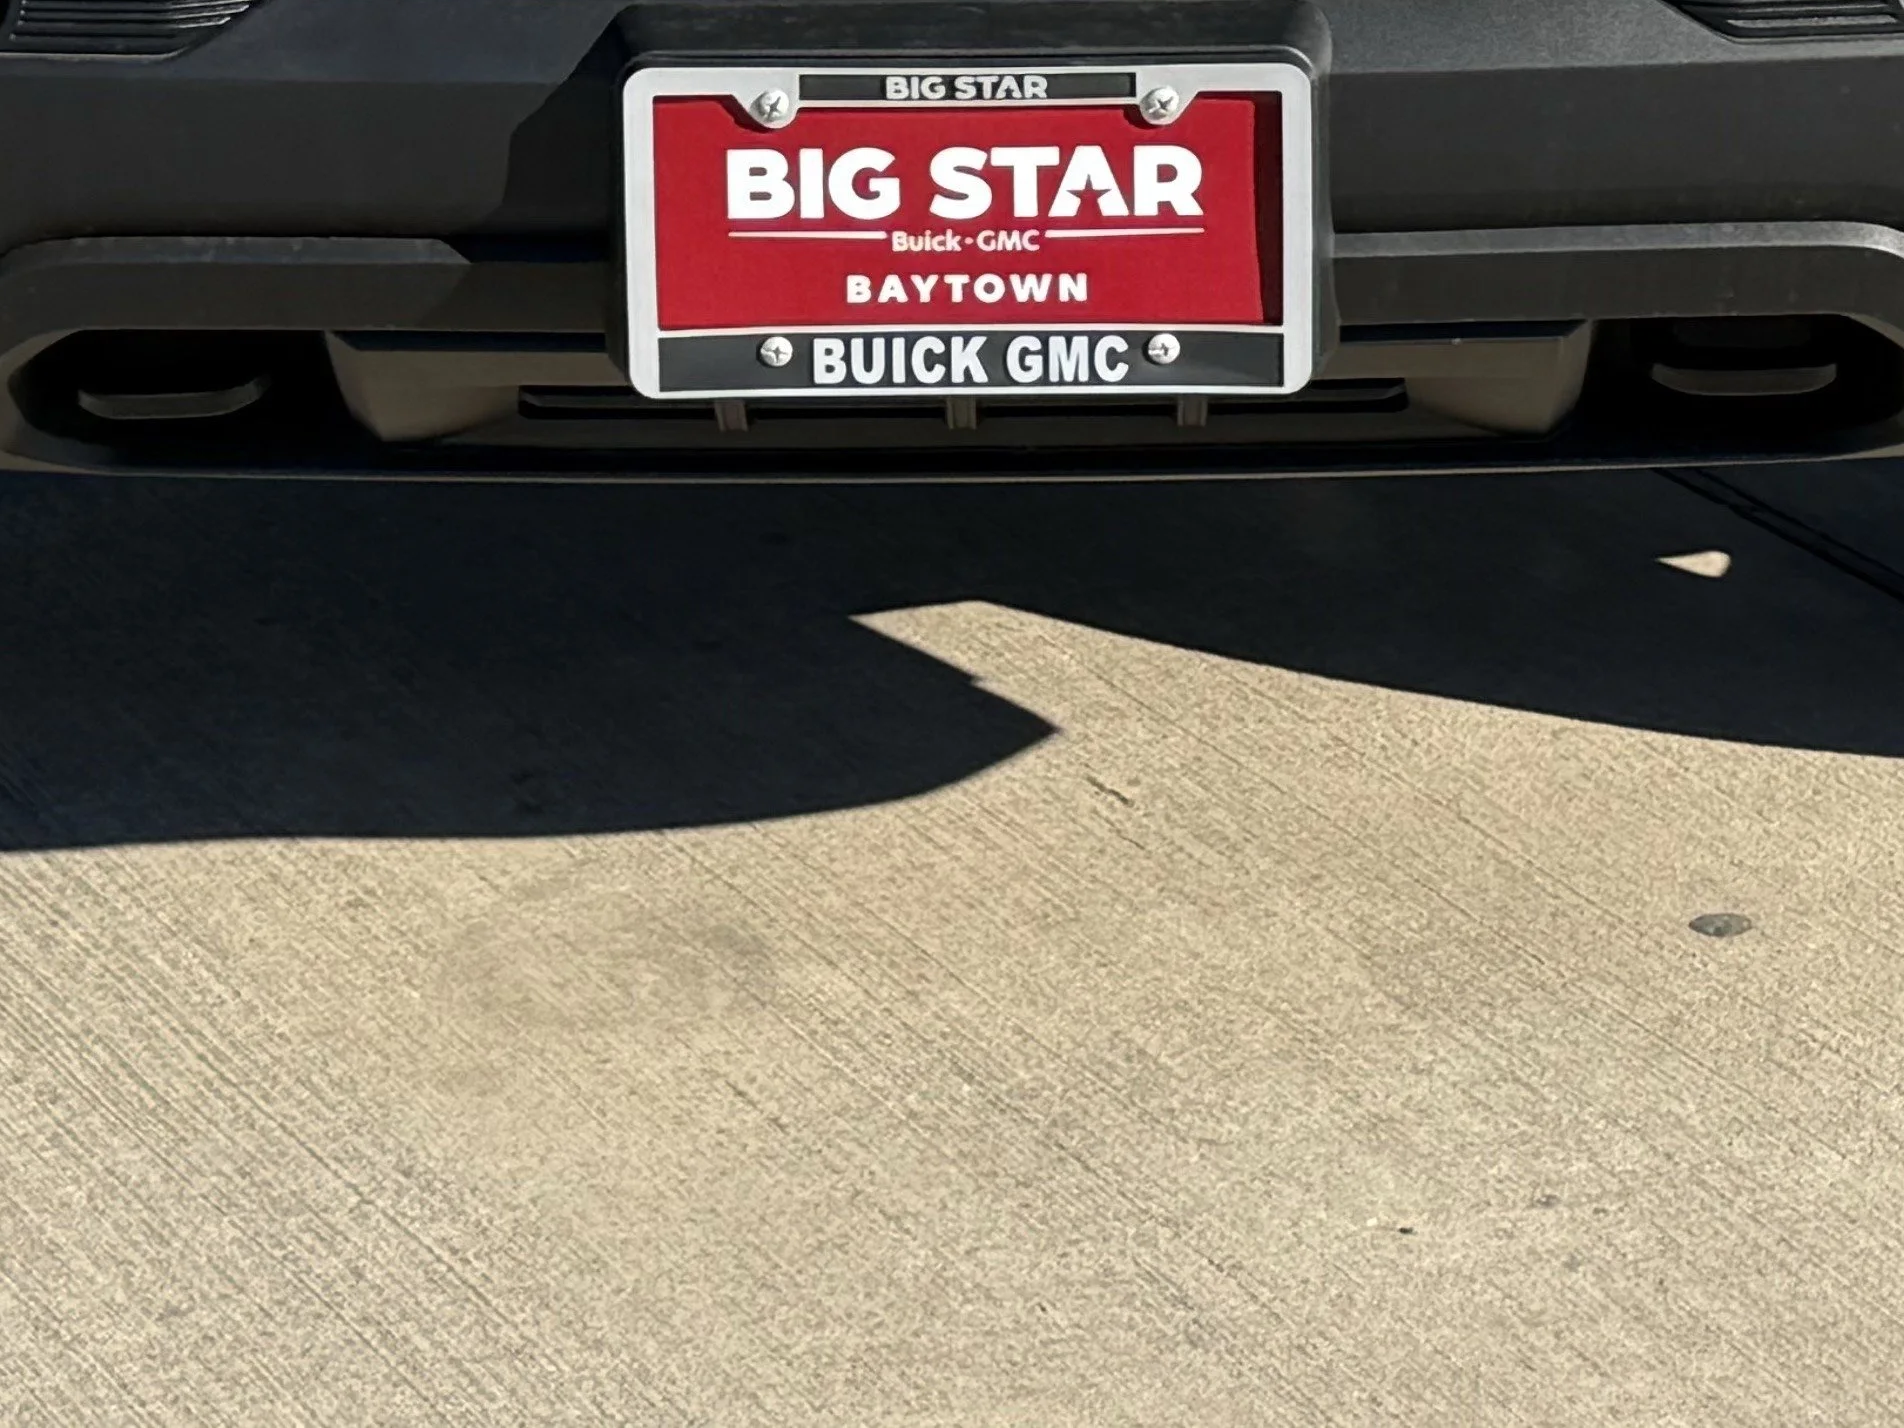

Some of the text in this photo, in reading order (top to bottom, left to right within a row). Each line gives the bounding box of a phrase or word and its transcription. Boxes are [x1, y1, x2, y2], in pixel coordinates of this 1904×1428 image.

[885, 75, 1049, 100] BIG STAR
[725, 144, 1205, 221] BIG STAR
[845, 272, 1089, 305] BAYTOWN
[812, 333, 1132, 386] BUICK GMC
